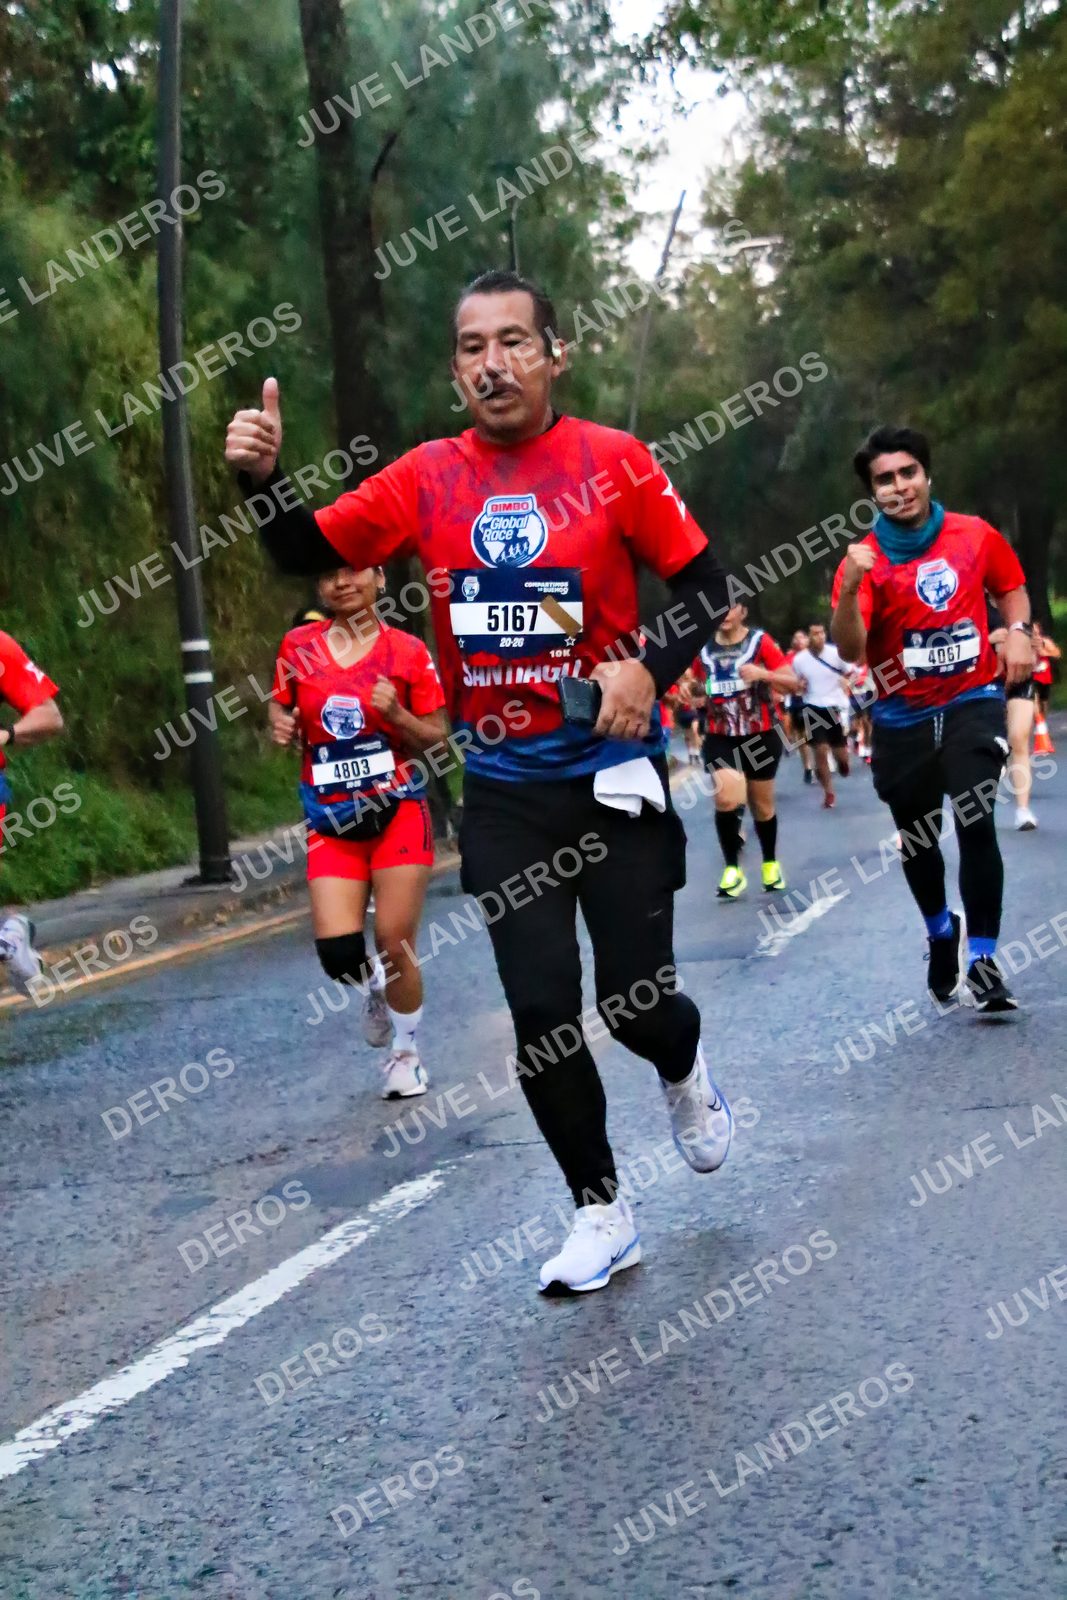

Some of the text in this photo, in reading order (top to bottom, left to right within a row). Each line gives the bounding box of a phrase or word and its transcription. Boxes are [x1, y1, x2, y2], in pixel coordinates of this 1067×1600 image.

[491, 502, 529, 512] BIMBO
[490, 515, 529, 529] Global
[482, 528, 513, 541] Race
[487, 604, 539, 632] 5167
[549, 649, 571, 658] 10K
[928, 644, 962, 665] 4067
[333, 758, 371, 779] 4803
